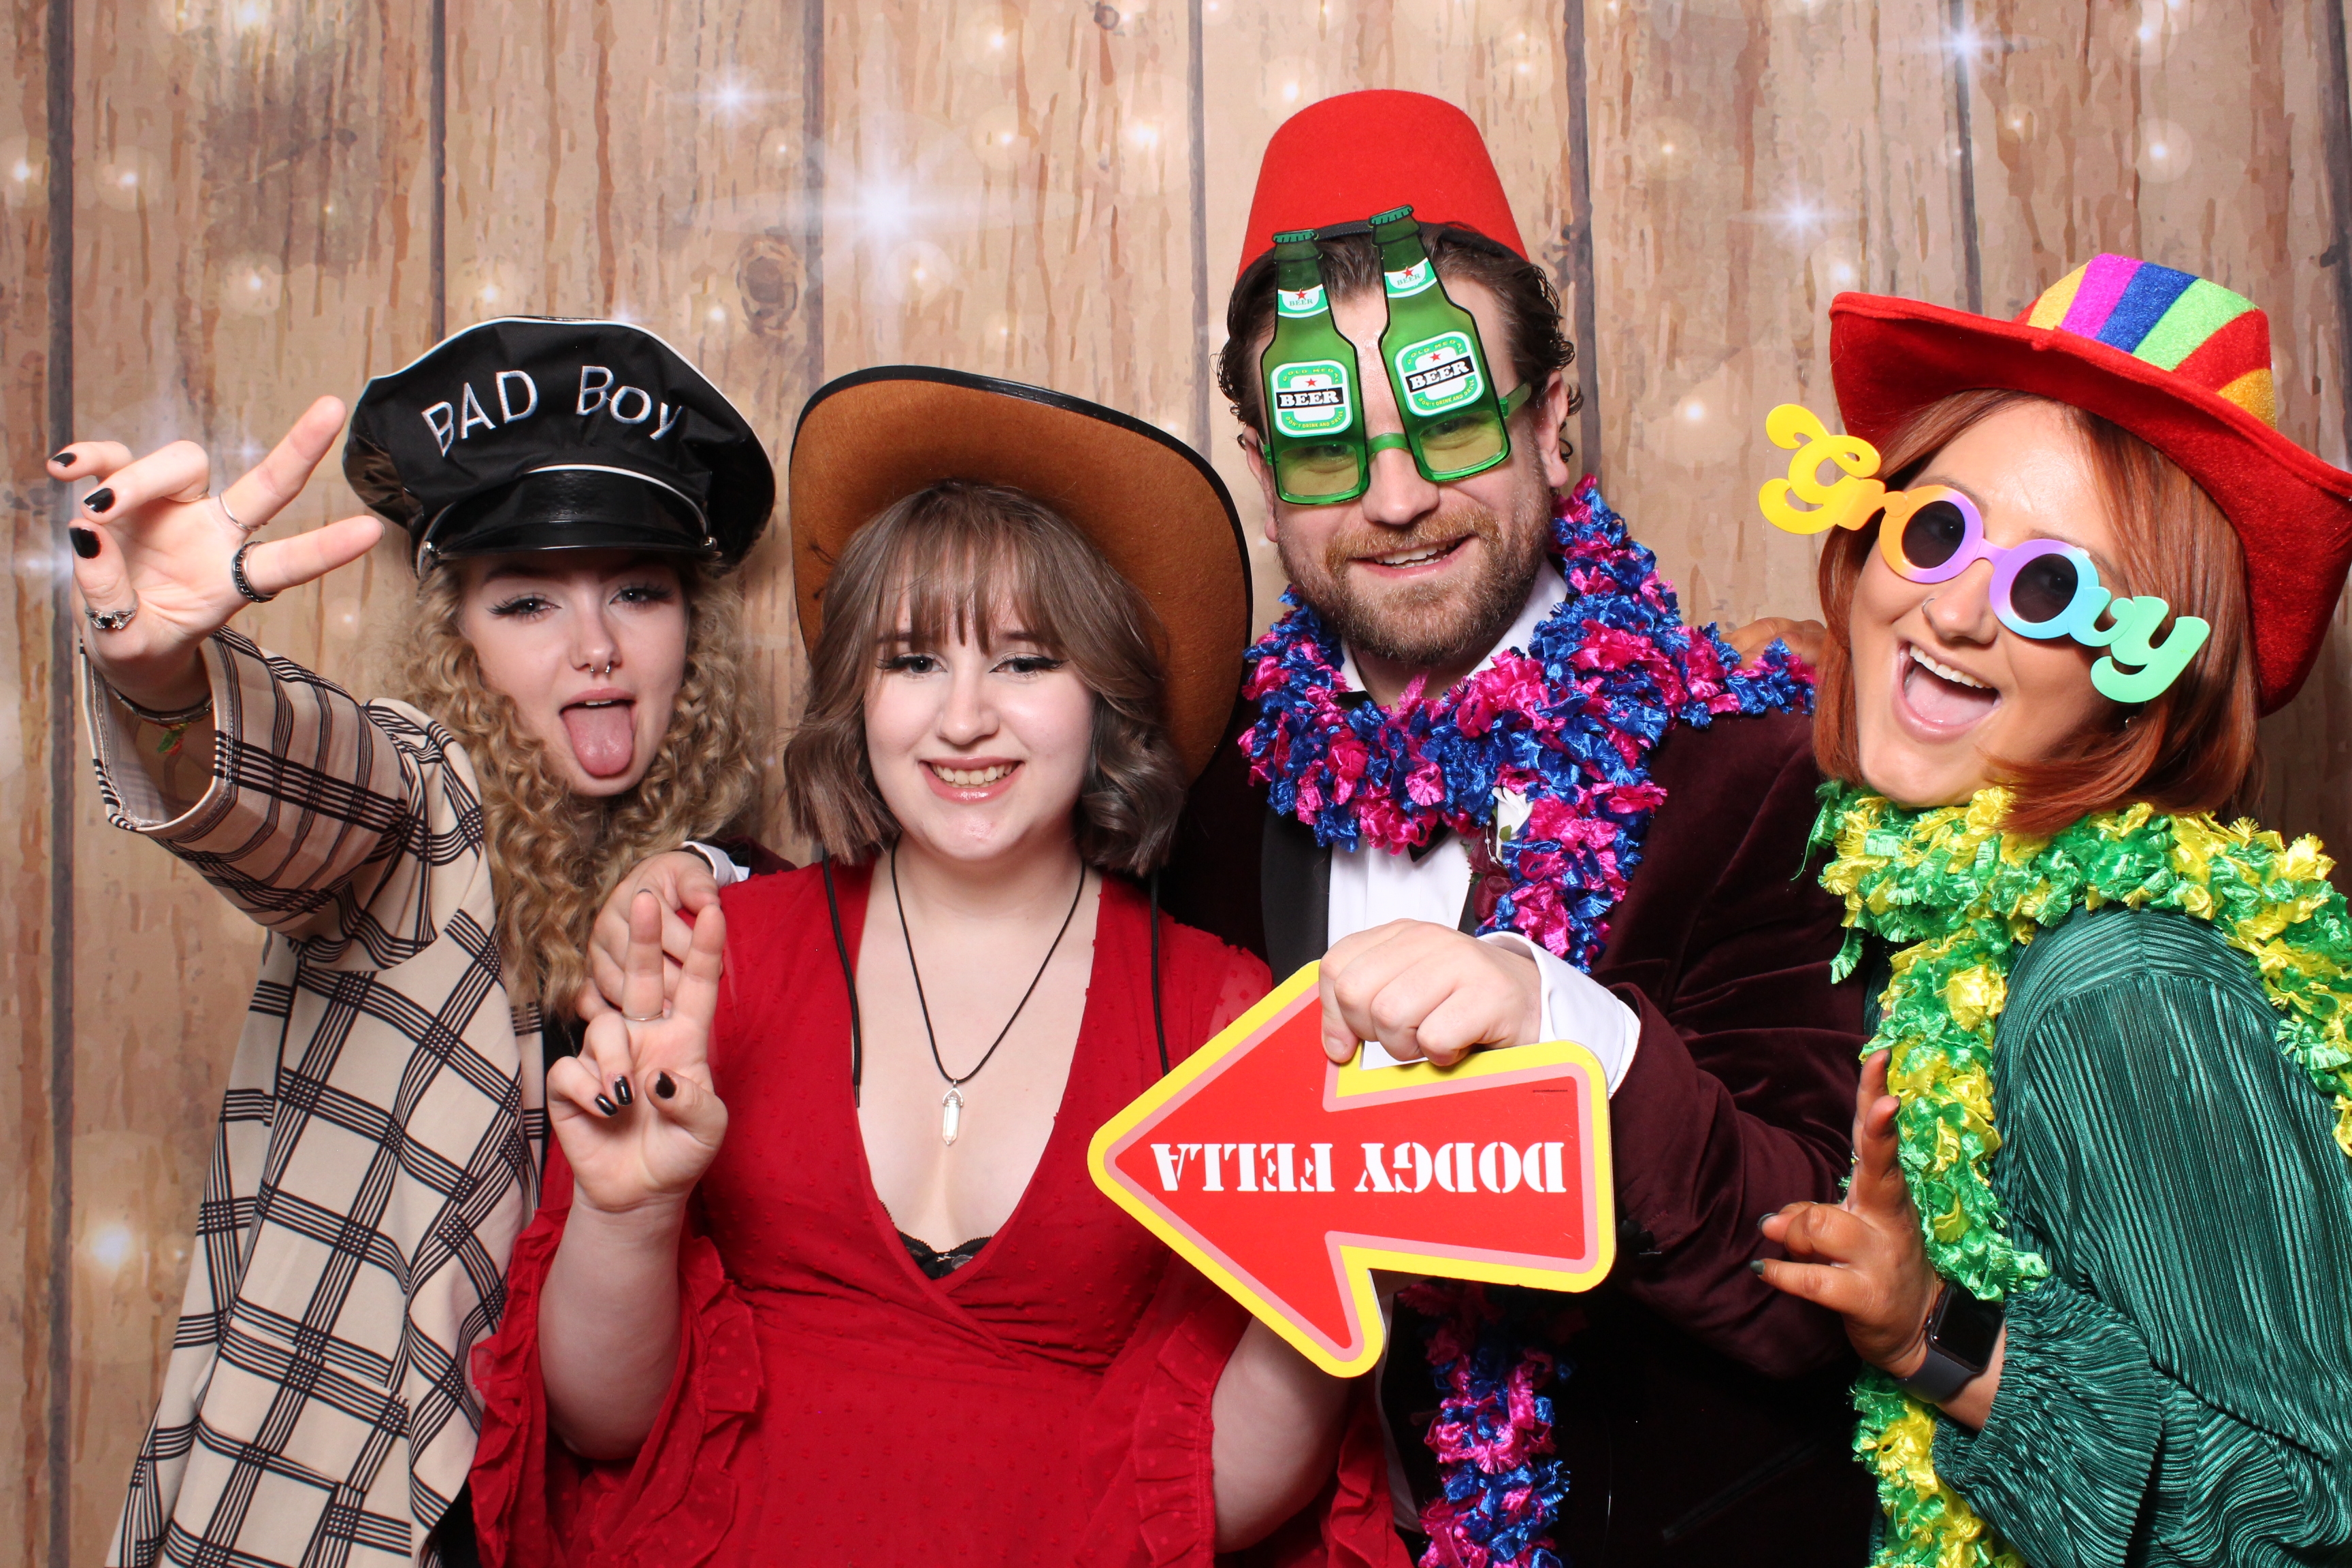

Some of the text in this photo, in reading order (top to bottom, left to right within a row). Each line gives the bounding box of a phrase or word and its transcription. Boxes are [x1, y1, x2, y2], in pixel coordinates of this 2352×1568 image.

[1396, 274, 1420, 286] BEER
[1407, 340, 1463, 365] GOLD MEDAL
[1283, 368, 1339, 383] GOLD MEDAL
[1409, 361, 1470, 390] BEER
[1279, 390, 1340, 407] BEER
[1418, 397, 1435, 406] DON'T
[1435, 397, 1452, 406] DRINK
[1463, 379, 1475, 395] DRIVE
[421, 370, 538, 457] BAD
[1286, 416, 1301, 427] DON'T
[1330, 410, 1343, 425] DRIVE
[1150, 1141, 1567, 1193] DODGY FELLA
